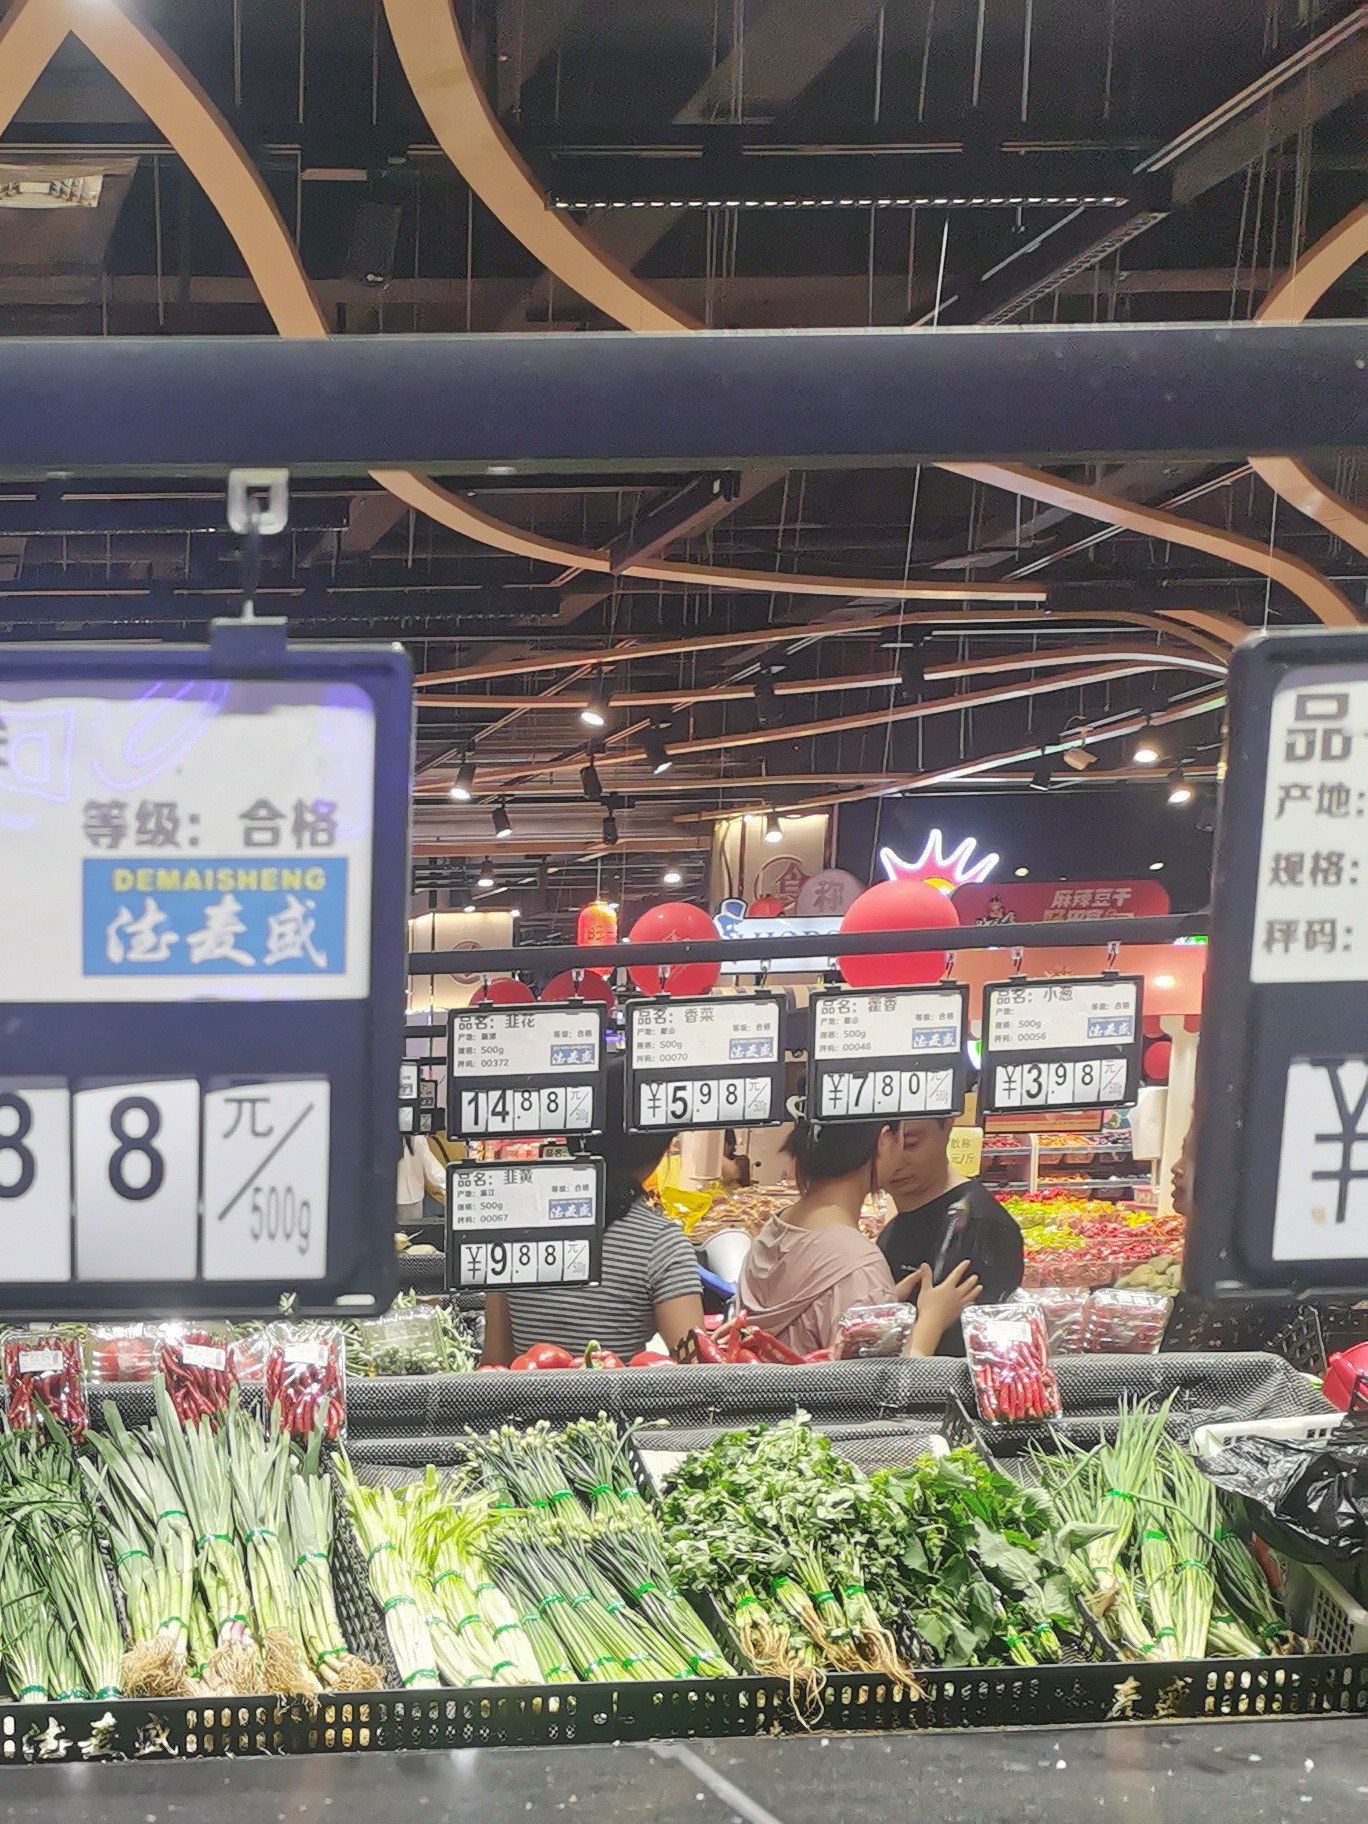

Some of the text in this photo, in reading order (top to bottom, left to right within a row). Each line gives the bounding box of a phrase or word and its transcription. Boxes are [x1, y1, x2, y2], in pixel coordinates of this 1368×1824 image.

[1275, 782, 1367, 821] 产地：
[83, 801, 340, 850] 等级： 合格
[1269, 852, 1361, 890] 规格：
[112, 866, 327, 893] DEMAISHENG
[1018, 1020, 1042, 1029] 500g
[843, 1030, 867, 1039] 500g
[660, 1041, 682, 1049] 500g
[481, 1045, 504, 1055] 500g
[660, 1053, 688, 1061] 00070
[481, 1058, 509, 1067] 00372
[480, 1202, 503, 1211] 500g
[480, 1214, 508, 1223] 00067
